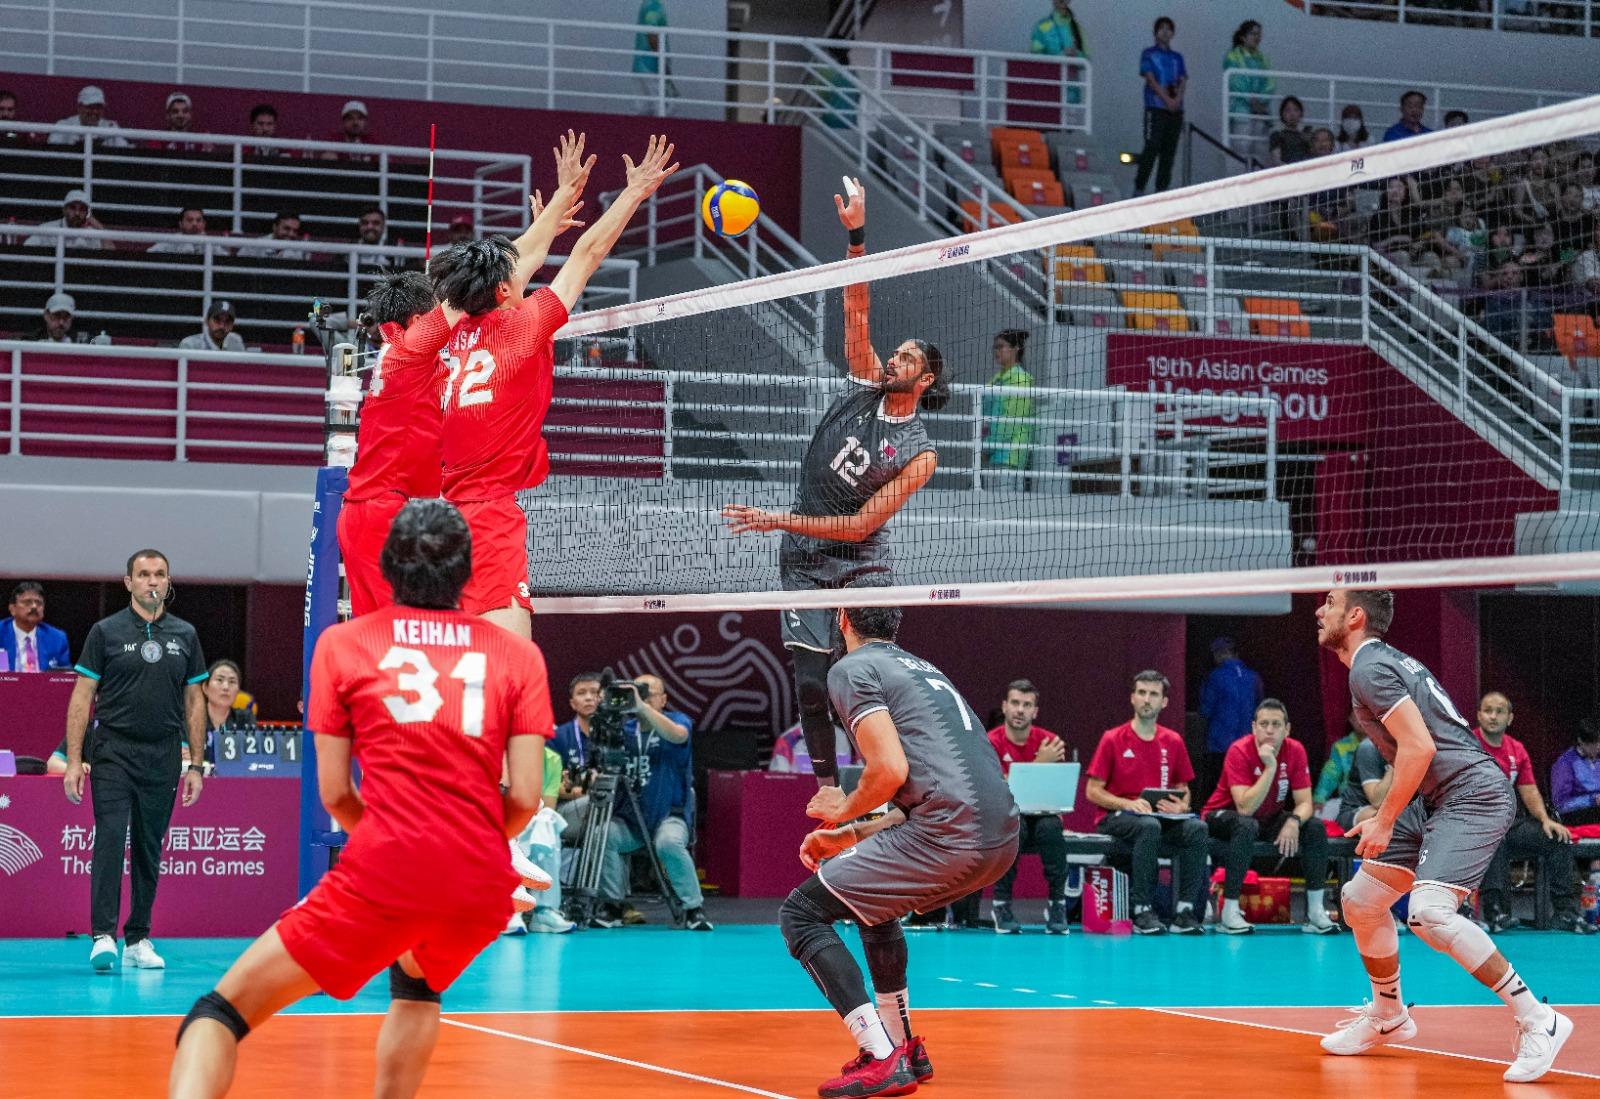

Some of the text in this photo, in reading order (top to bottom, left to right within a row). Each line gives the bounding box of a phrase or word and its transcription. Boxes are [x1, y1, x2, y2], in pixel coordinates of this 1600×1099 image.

[1147, 356, 1329, 386] 19th Asian Games
[393, 619, 471, 647] KEIHAN
[378, 646, 487, 738] 31
[925, 677, 973, 731] 7
[224, 736, 296, 761] 3 2 0 1
[60, 825, 267, 852] 杭届亚运会
[60, 856, 265, 876] The sian Games
